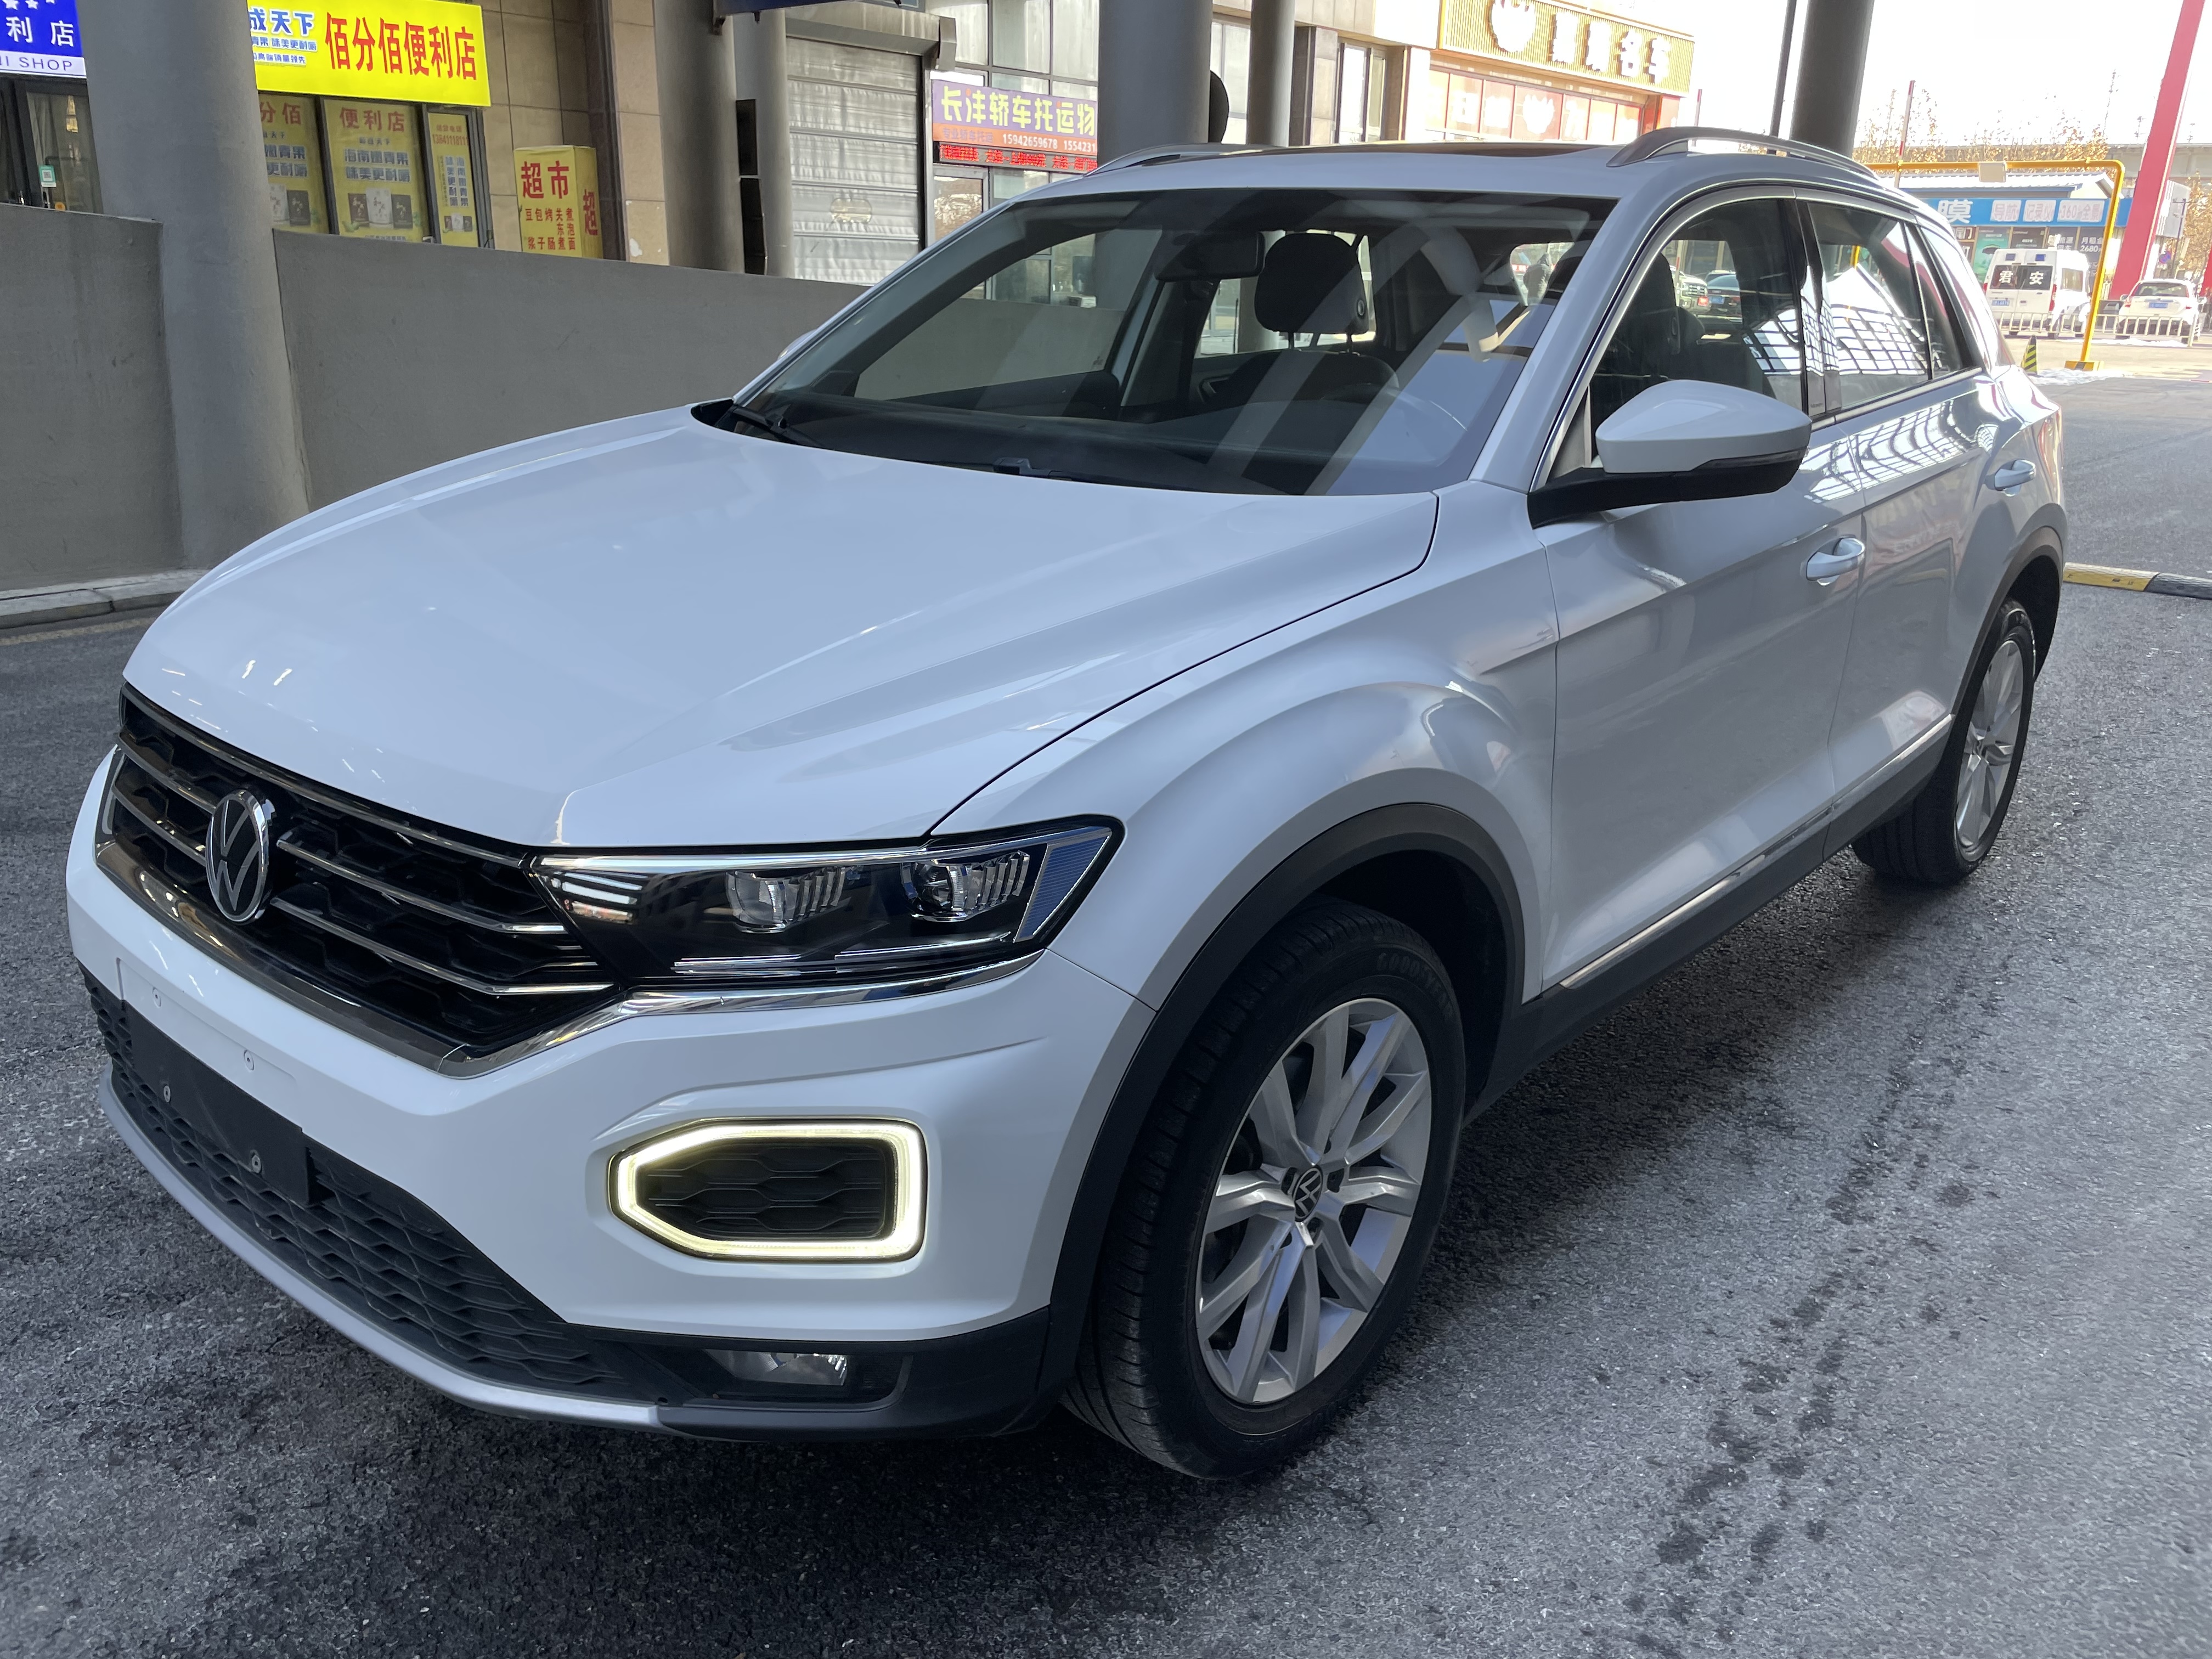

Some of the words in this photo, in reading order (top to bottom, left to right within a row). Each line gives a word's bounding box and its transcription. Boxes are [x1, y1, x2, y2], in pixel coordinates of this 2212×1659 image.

[5, 16, 74, 47] 利店
[249, 8, 313, 35] 成天下
[325, 12, 477, 81] 佰分佰便利店
[0, 55, 9, 66] I
[19, 57, 72, 71] SHOP
[260, 101, 302, 125] 分佰
[339, 106, 405, 132] 便利店
[1002, 133, 1058, 149] 15942659678
[1063, 140, 1097, 153] 1554231
[521, 160, 569, 199] 超市
[583, 188, 598, 235] 超
[1938, 199, 1973, 224] 膜
[1994, 203, 2018, 222] 导航
[2025, 203, 2053, 222] 记录仪
[1999, 269, 2045, 285] 君安
